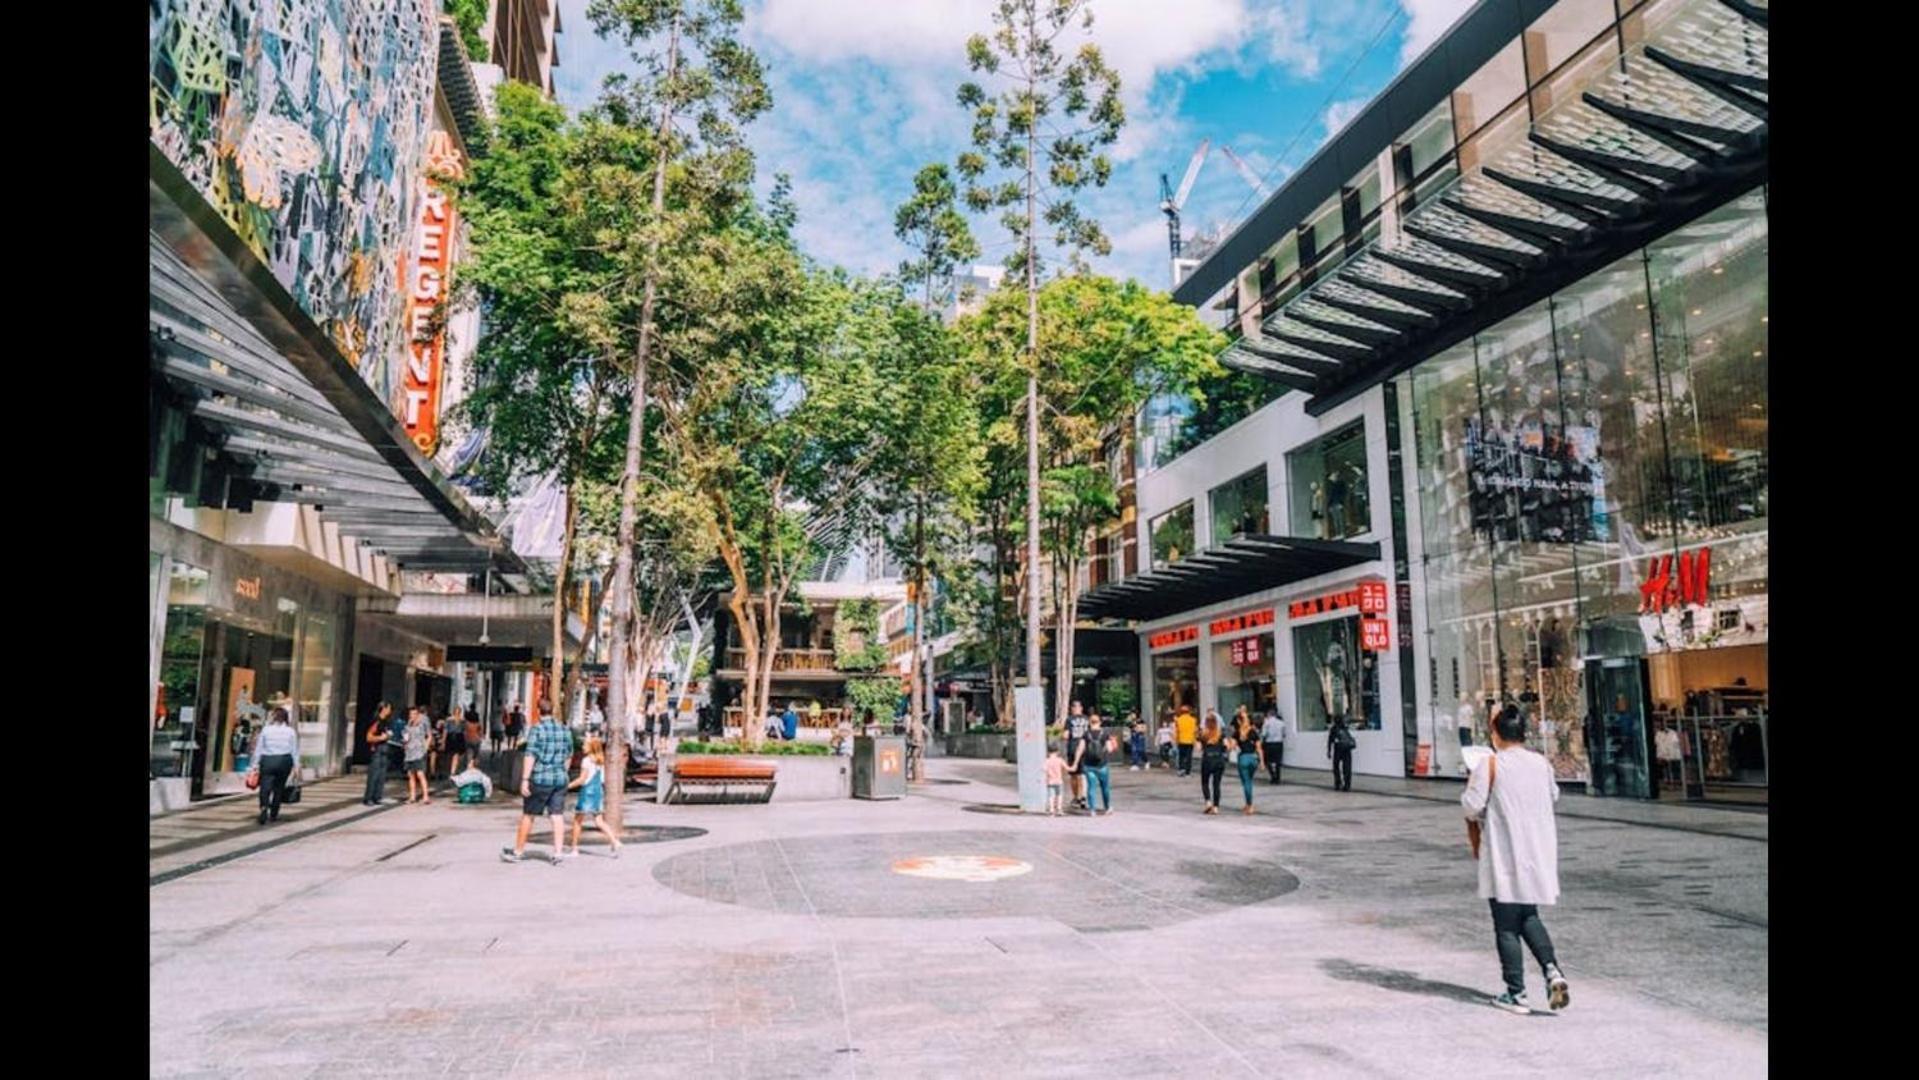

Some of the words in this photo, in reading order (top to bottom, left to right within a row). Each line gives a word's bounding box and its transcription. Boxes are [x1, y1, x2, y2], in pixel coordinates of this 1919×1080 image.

[406, 180, 446, 427] REGENT
[1639, 547, 1711, 617] H&M
[1364, 622, 1385, 634] UNI
[1365, 634, 1388, 647] QLO
